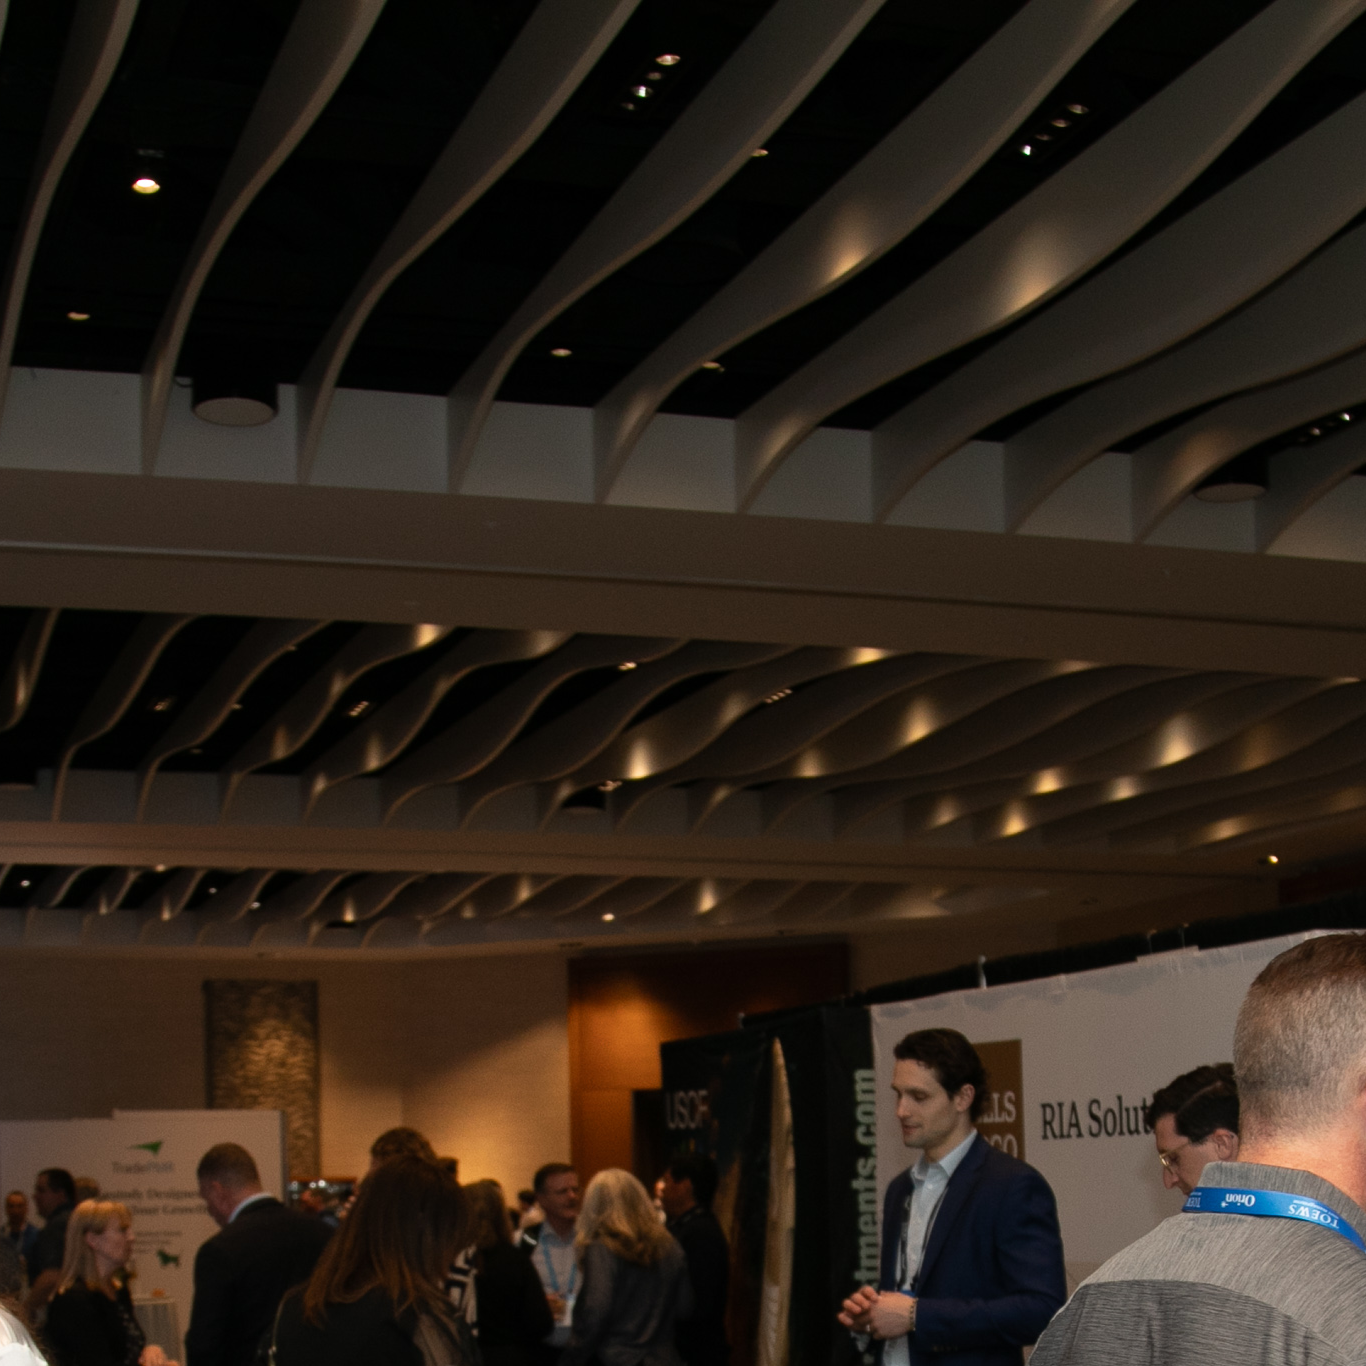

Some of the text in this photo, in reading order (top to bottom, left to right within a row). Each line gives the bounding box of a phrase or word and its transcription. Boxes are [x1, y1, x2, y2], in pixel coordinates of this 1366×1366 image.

[1041, 1095, 1152, 1140] RIA Solut
[1225, 1193, 1256, 1208] Orion
[1288, 1203, 1340, 1230] TOEWS
